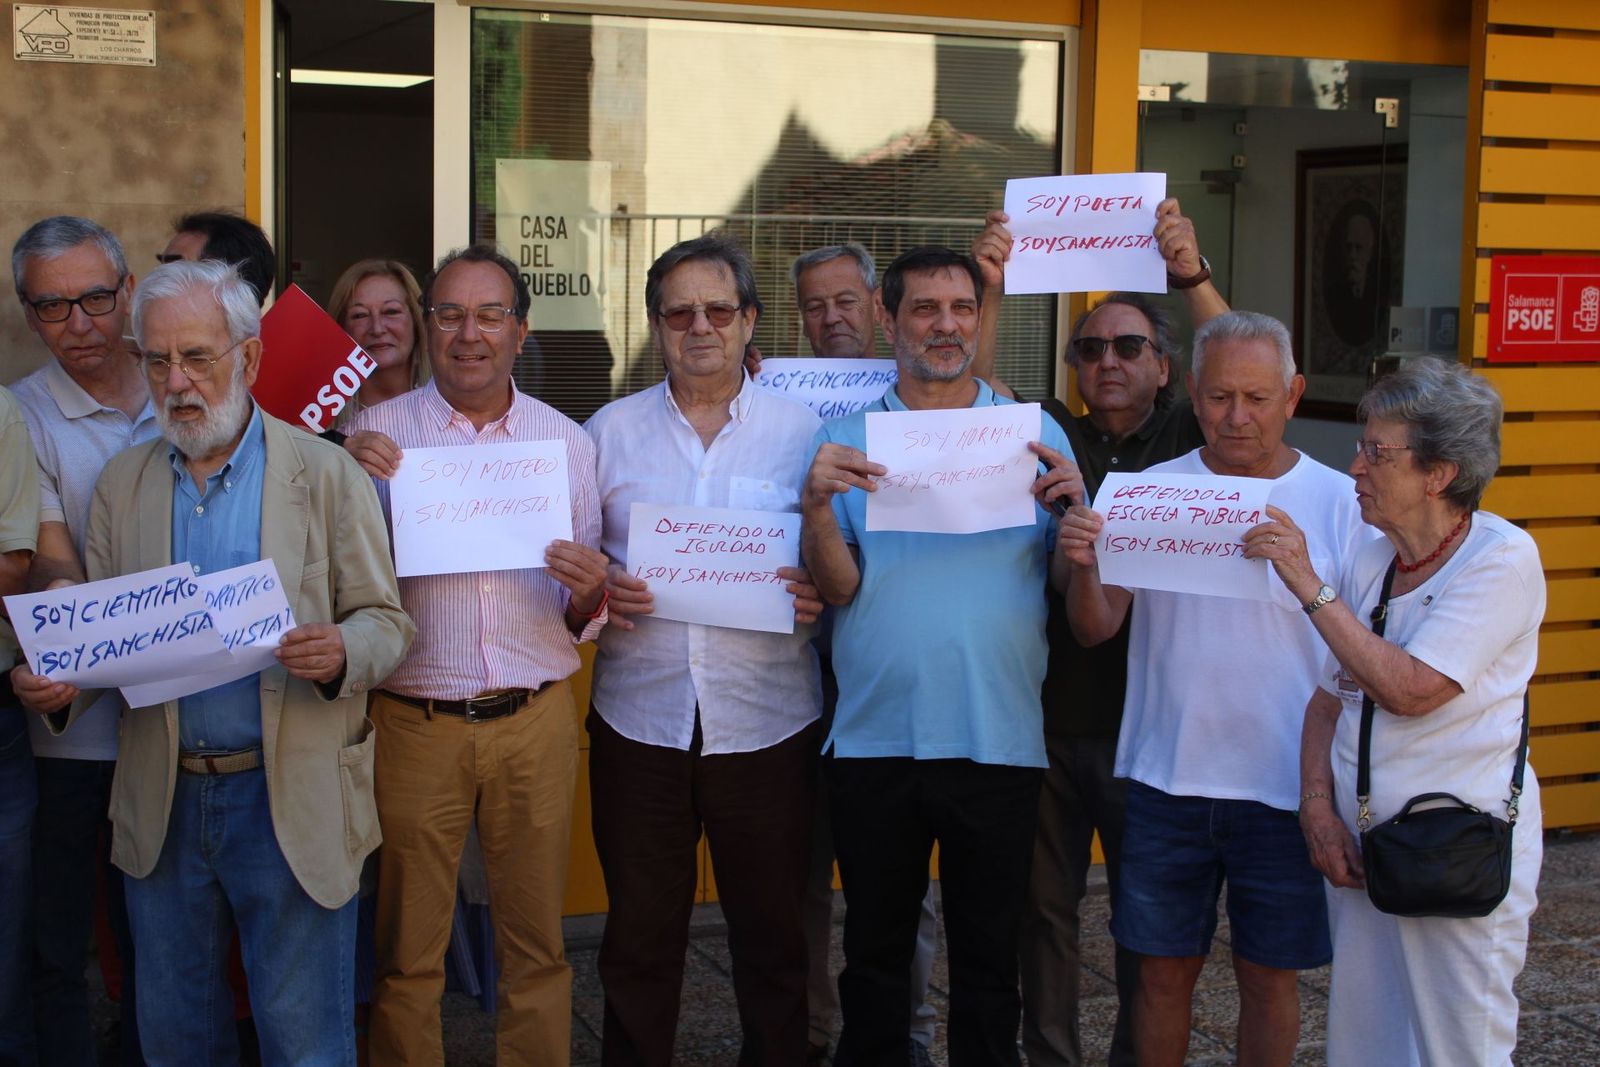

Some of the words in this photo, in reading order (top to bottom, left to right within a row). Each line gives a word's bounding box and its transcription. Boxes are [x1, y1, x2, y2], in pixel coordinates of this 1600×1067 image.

[520, 215, 568, 239] CASA
[520, 244, 554, 267] DEL
[1508, 294, 1555, 308] Salamanca
[1507, 309, 1555, 331] PSOE
[300, 344, 378, 434] PSOE
[904, 430, 951, 452] SOY
[956, 423, 1025, 450] NORMAL
[418, 459, 473, 487] SOY
[479, 457, 559, 482] MOTERO
[1107, 504, 1178, 522] ESCUELA
[1188, 506, 1260, 526] PUBLICA
[32, 598, 76, 633] SOY
